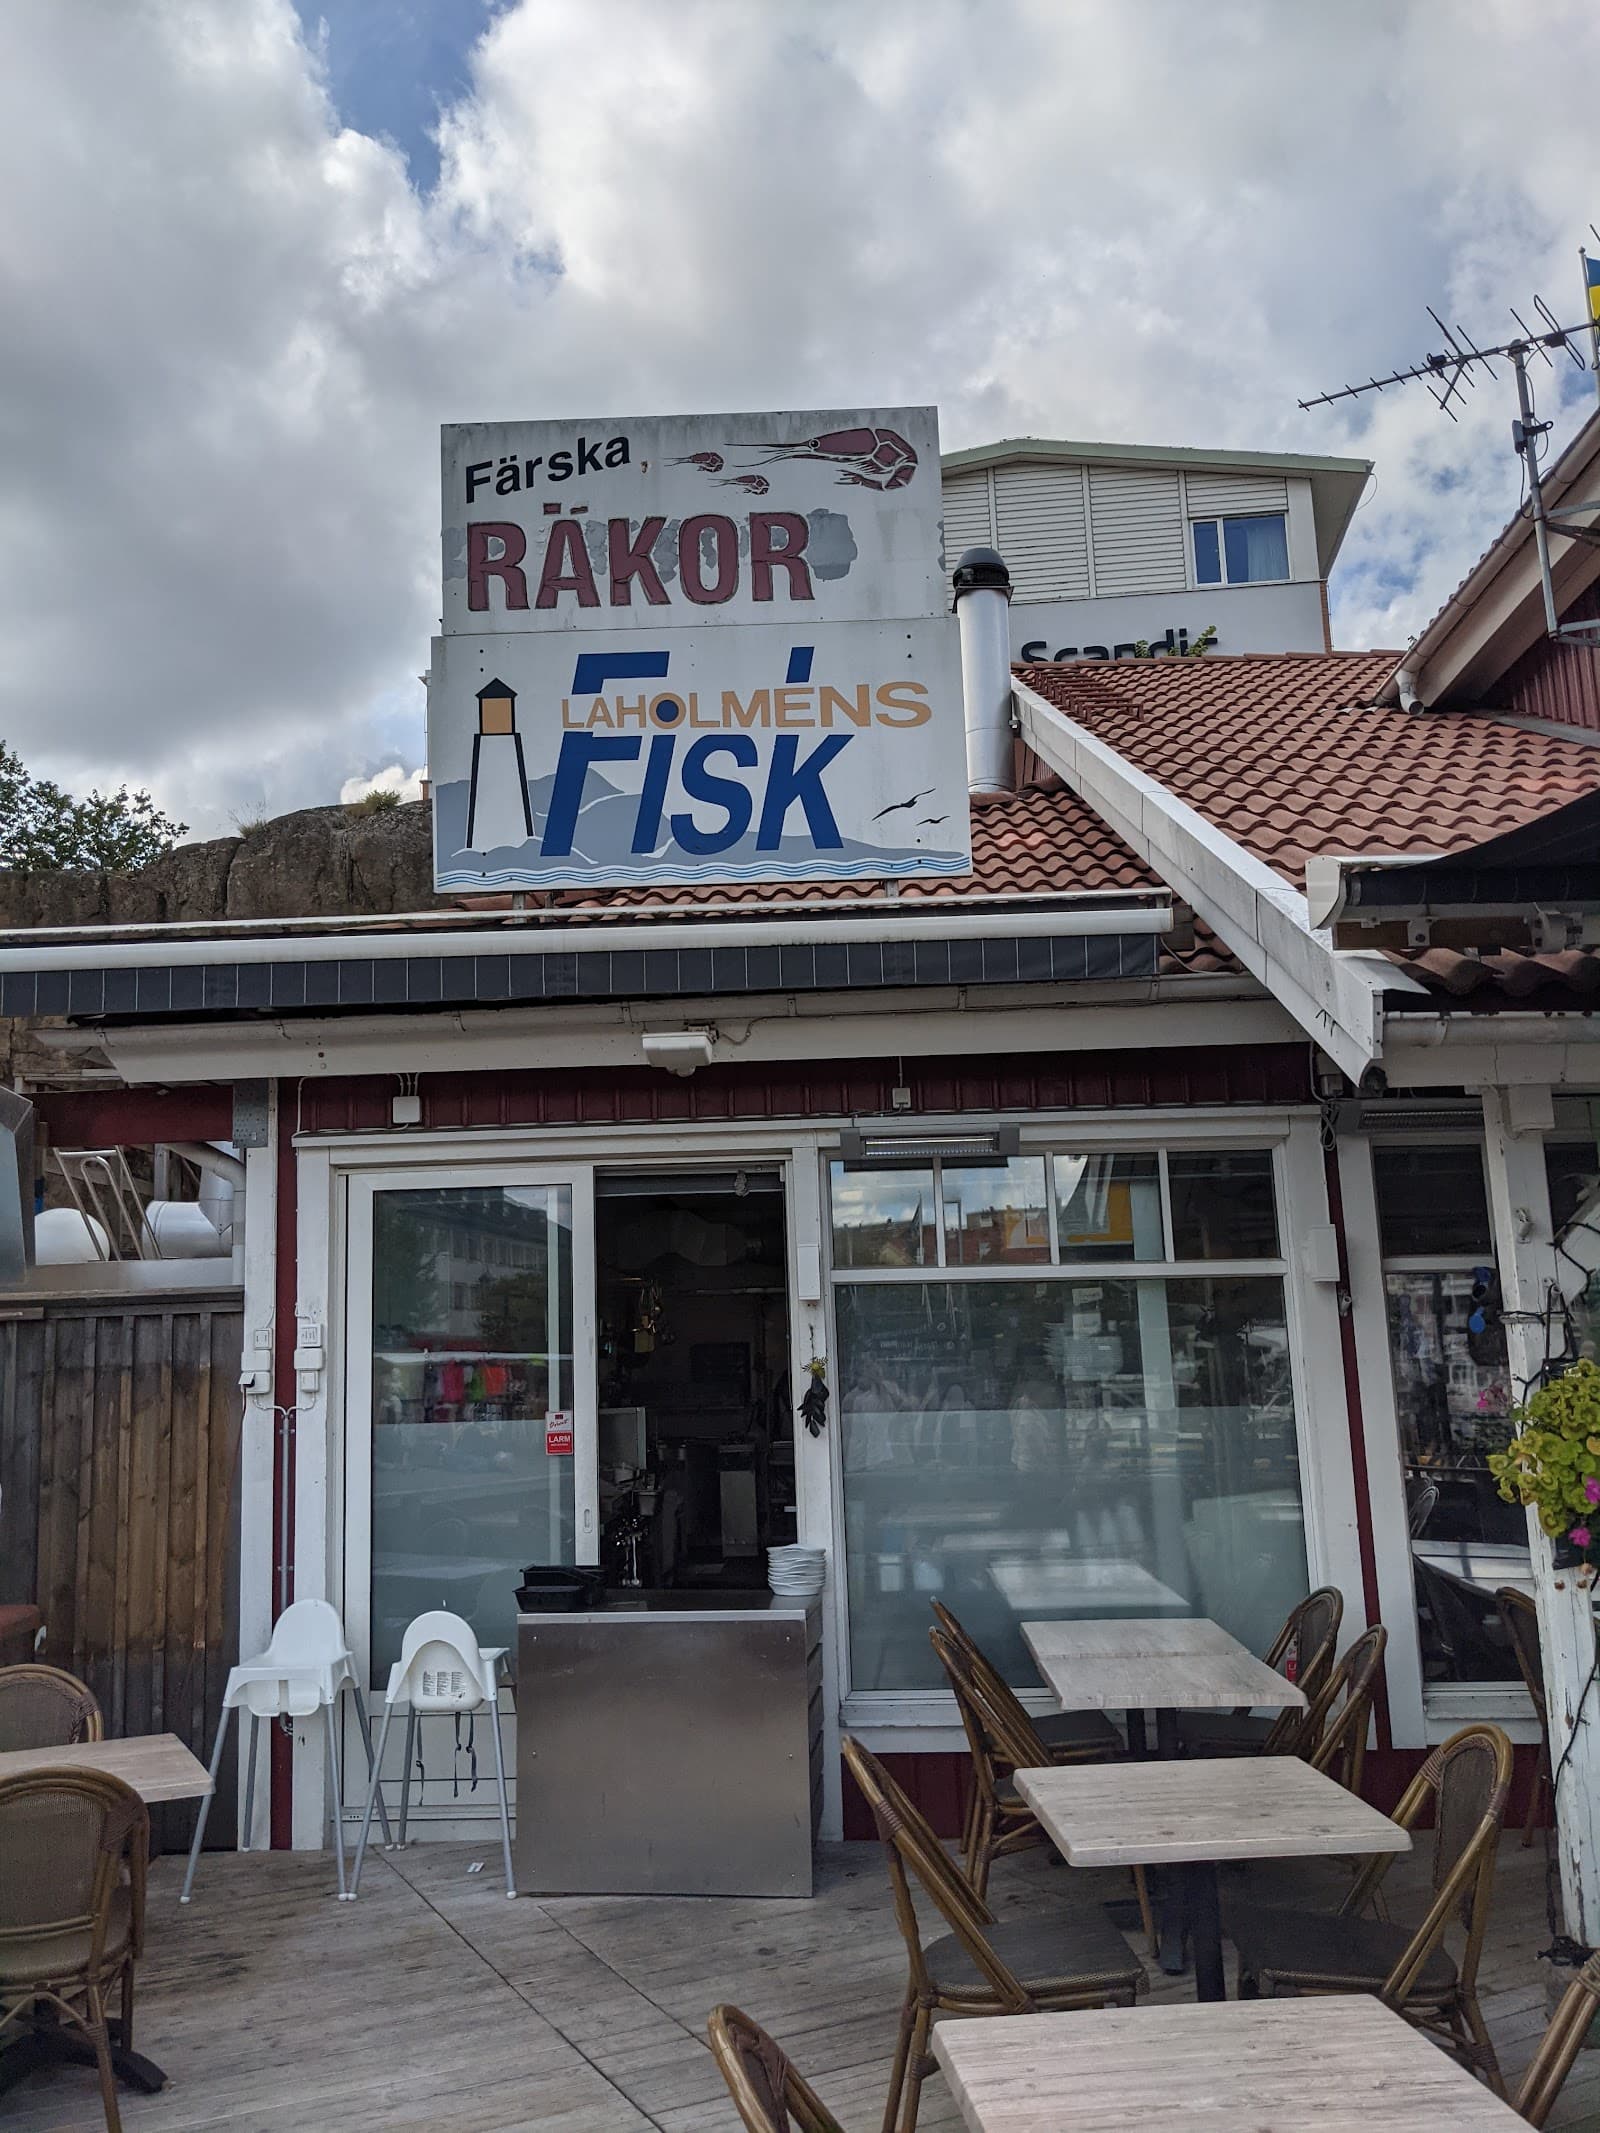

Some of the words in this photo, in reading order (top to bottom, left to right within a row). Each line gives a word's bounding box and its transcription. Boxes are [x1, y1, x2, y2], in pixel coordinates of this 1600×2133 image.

[465, 437, 631, 503] Färska
[467, 502, 815, 611] RÄKOR
[562, 682, 932, 728] LAHOLMENS
[540, 647, 854, 856] FISK
